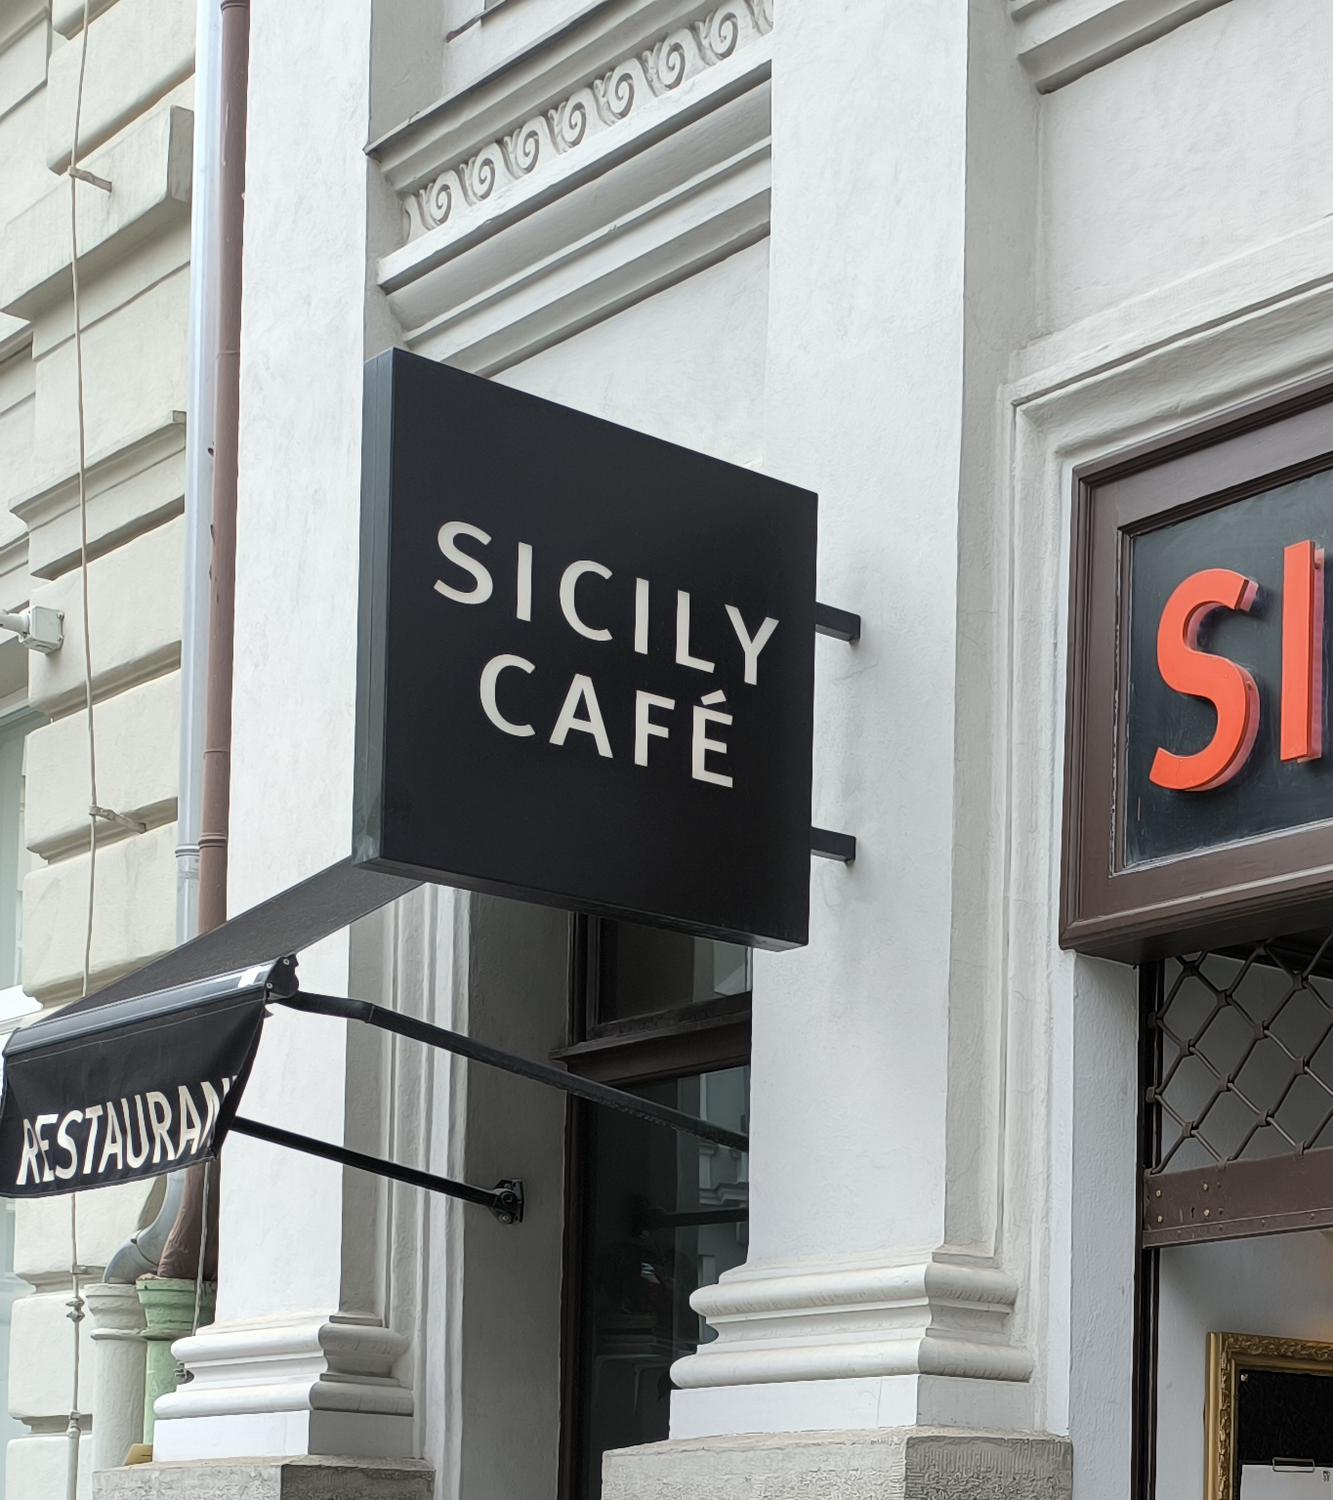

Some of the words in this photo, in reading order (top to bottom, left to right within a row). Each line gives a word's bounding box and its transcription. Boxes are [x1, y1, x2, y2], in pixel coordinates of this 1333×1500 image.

[433, 520, 780, 686] SICILY
[480, 653, 734, 789] CAFÉ
[16, 1074, 238, 1186] RESTAURAN
